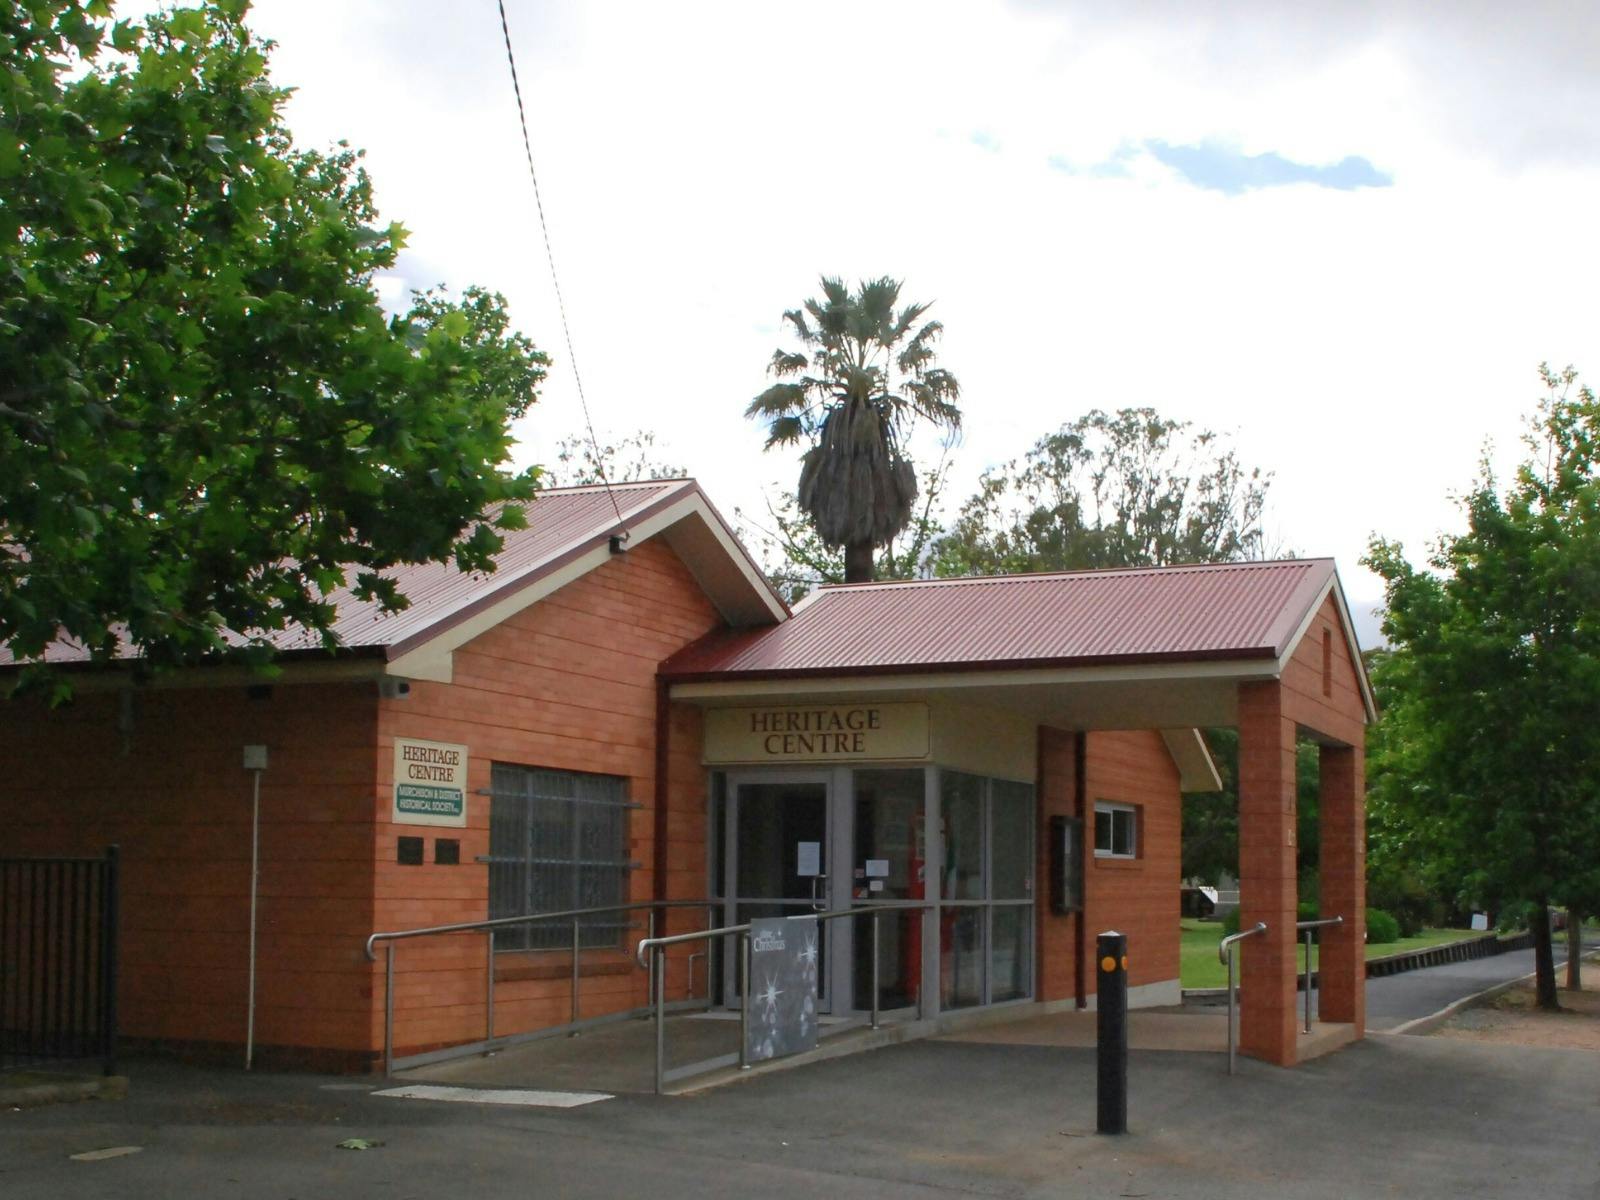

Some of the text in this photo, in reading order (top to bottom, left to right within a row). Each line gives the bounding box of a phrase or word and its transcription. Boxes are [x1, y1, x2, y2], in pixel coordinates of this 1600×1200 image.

[750, 709, 881, 732] HERITAGE
[764, 733, 866, 754] CENTRE
[403, 745, 459, 766] HERITAGE
[408, 763, 454, 782] CENTRE
